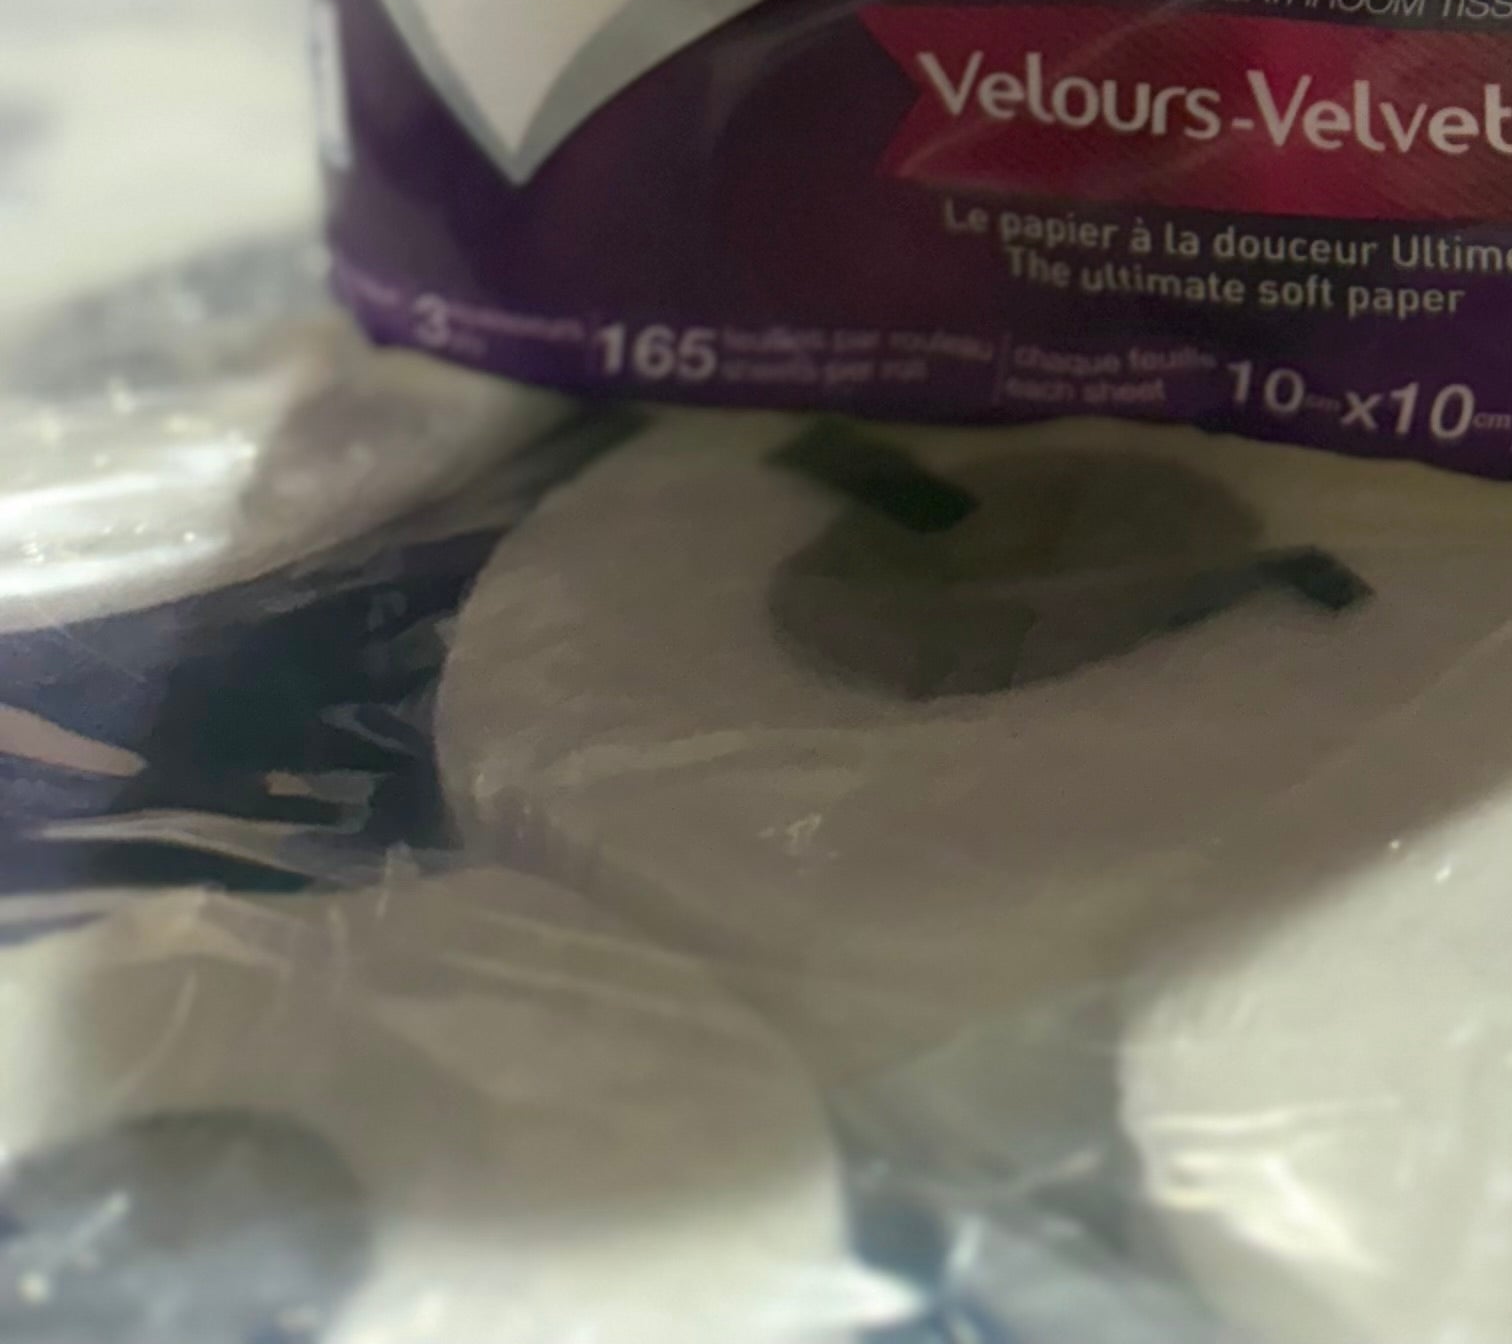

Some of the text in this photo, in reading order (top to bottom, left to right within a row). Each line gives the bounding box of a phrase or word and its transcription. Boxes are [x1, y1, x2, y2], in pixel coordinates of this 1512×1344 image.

[942, 198, 989, 234] Le
[998, 204, 1119, 252] papier
[1129, 217, 1150, 255] à
[1164, 221, 1202, 258] la
[1213, 224, 1378, 268] douceur
[1007, 244, 1465, 320] The ultimate soft paper
[598, 322, 717, 382] 165
